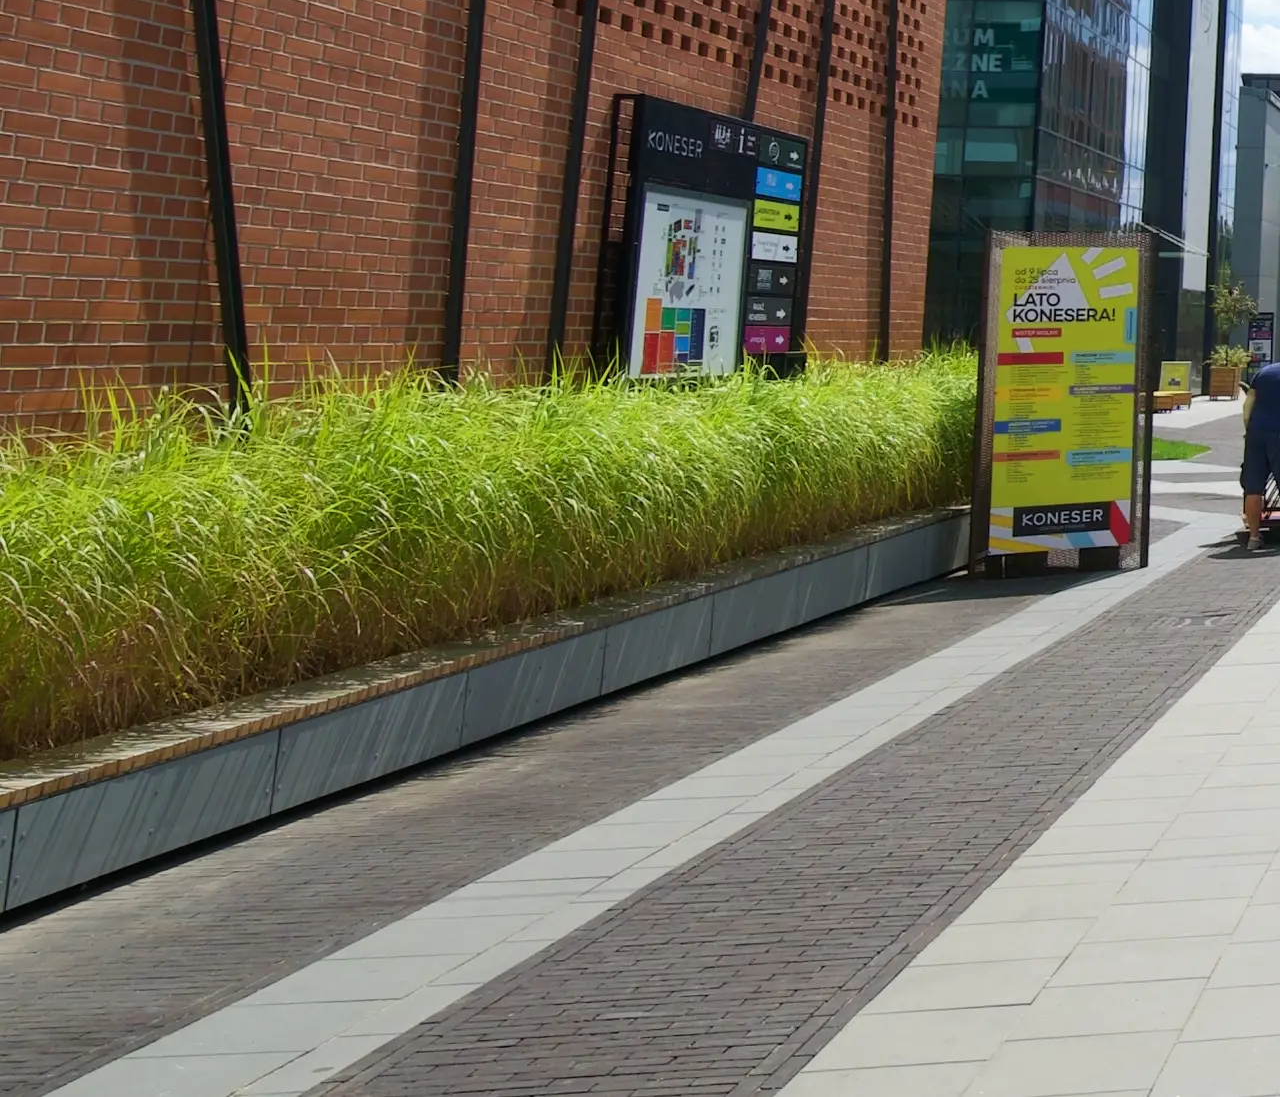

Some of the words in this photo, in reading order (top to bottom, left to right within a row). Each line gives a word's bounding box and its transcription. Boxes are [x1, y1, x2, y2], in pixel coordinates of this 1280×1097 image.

[647, 129, 703, 159] KONESER
[1014, 267, 1027, 276] od
[1029, 267, 1035, 276] 9
[1036, 267, 1059, 278] lipca
[1014, 276, 1027, 284] do
[1028, 276, 1039, 284] 25
[1041, 276, 1077, 286] sierpnia
[1013, 292, 1061, 308] LATO
[1012, 308, 1116, 323] KONESERA!
[1021, 508, 1104, 527] KONESER
